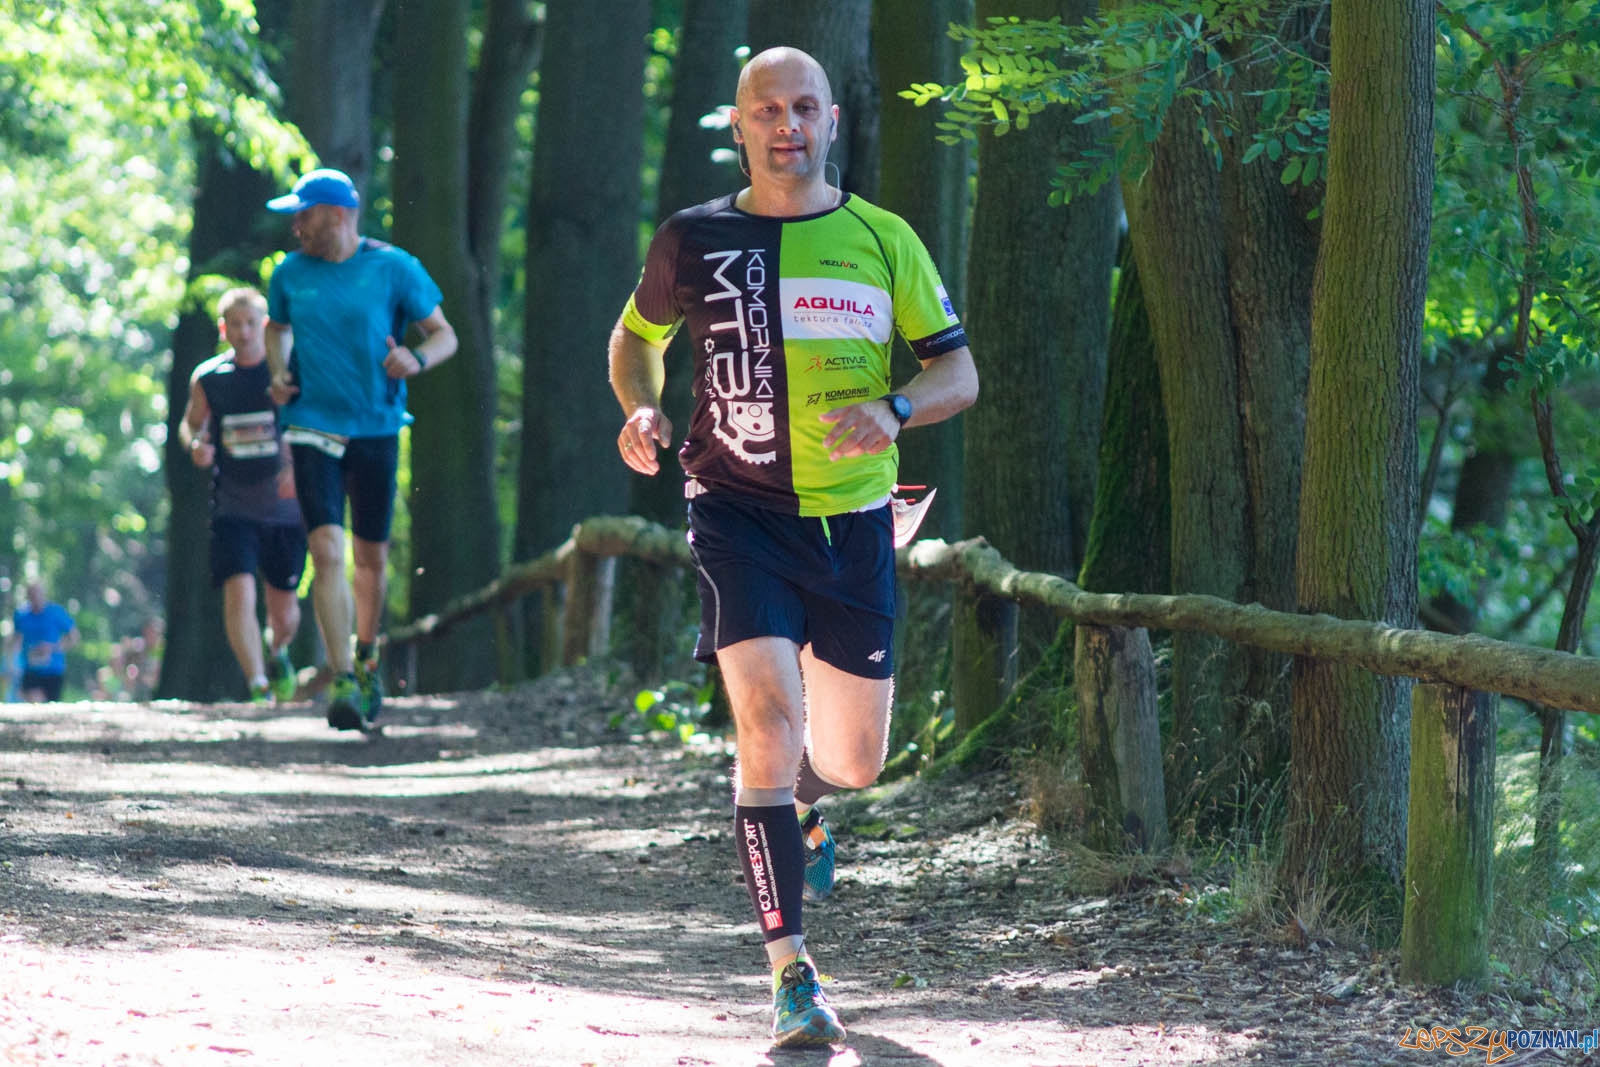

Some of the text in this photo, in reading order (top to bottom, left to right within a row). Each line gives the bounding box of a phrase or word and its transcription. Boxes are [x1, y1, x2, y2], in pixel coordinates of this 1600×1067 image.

[819, 259, 858, 270] VEZUVIO
[793, 296, 875, 317] AQUILA
[703, 250, 751, 399] MTB
[747, 249, 774, 398] KOMORNIKI
[793, 315, 840, 324] tektura
[824, 356, 868, 366] ACTIVUS
[704, 353, 717, 399] TEAM
[867, 649, 887, 663] 4F
